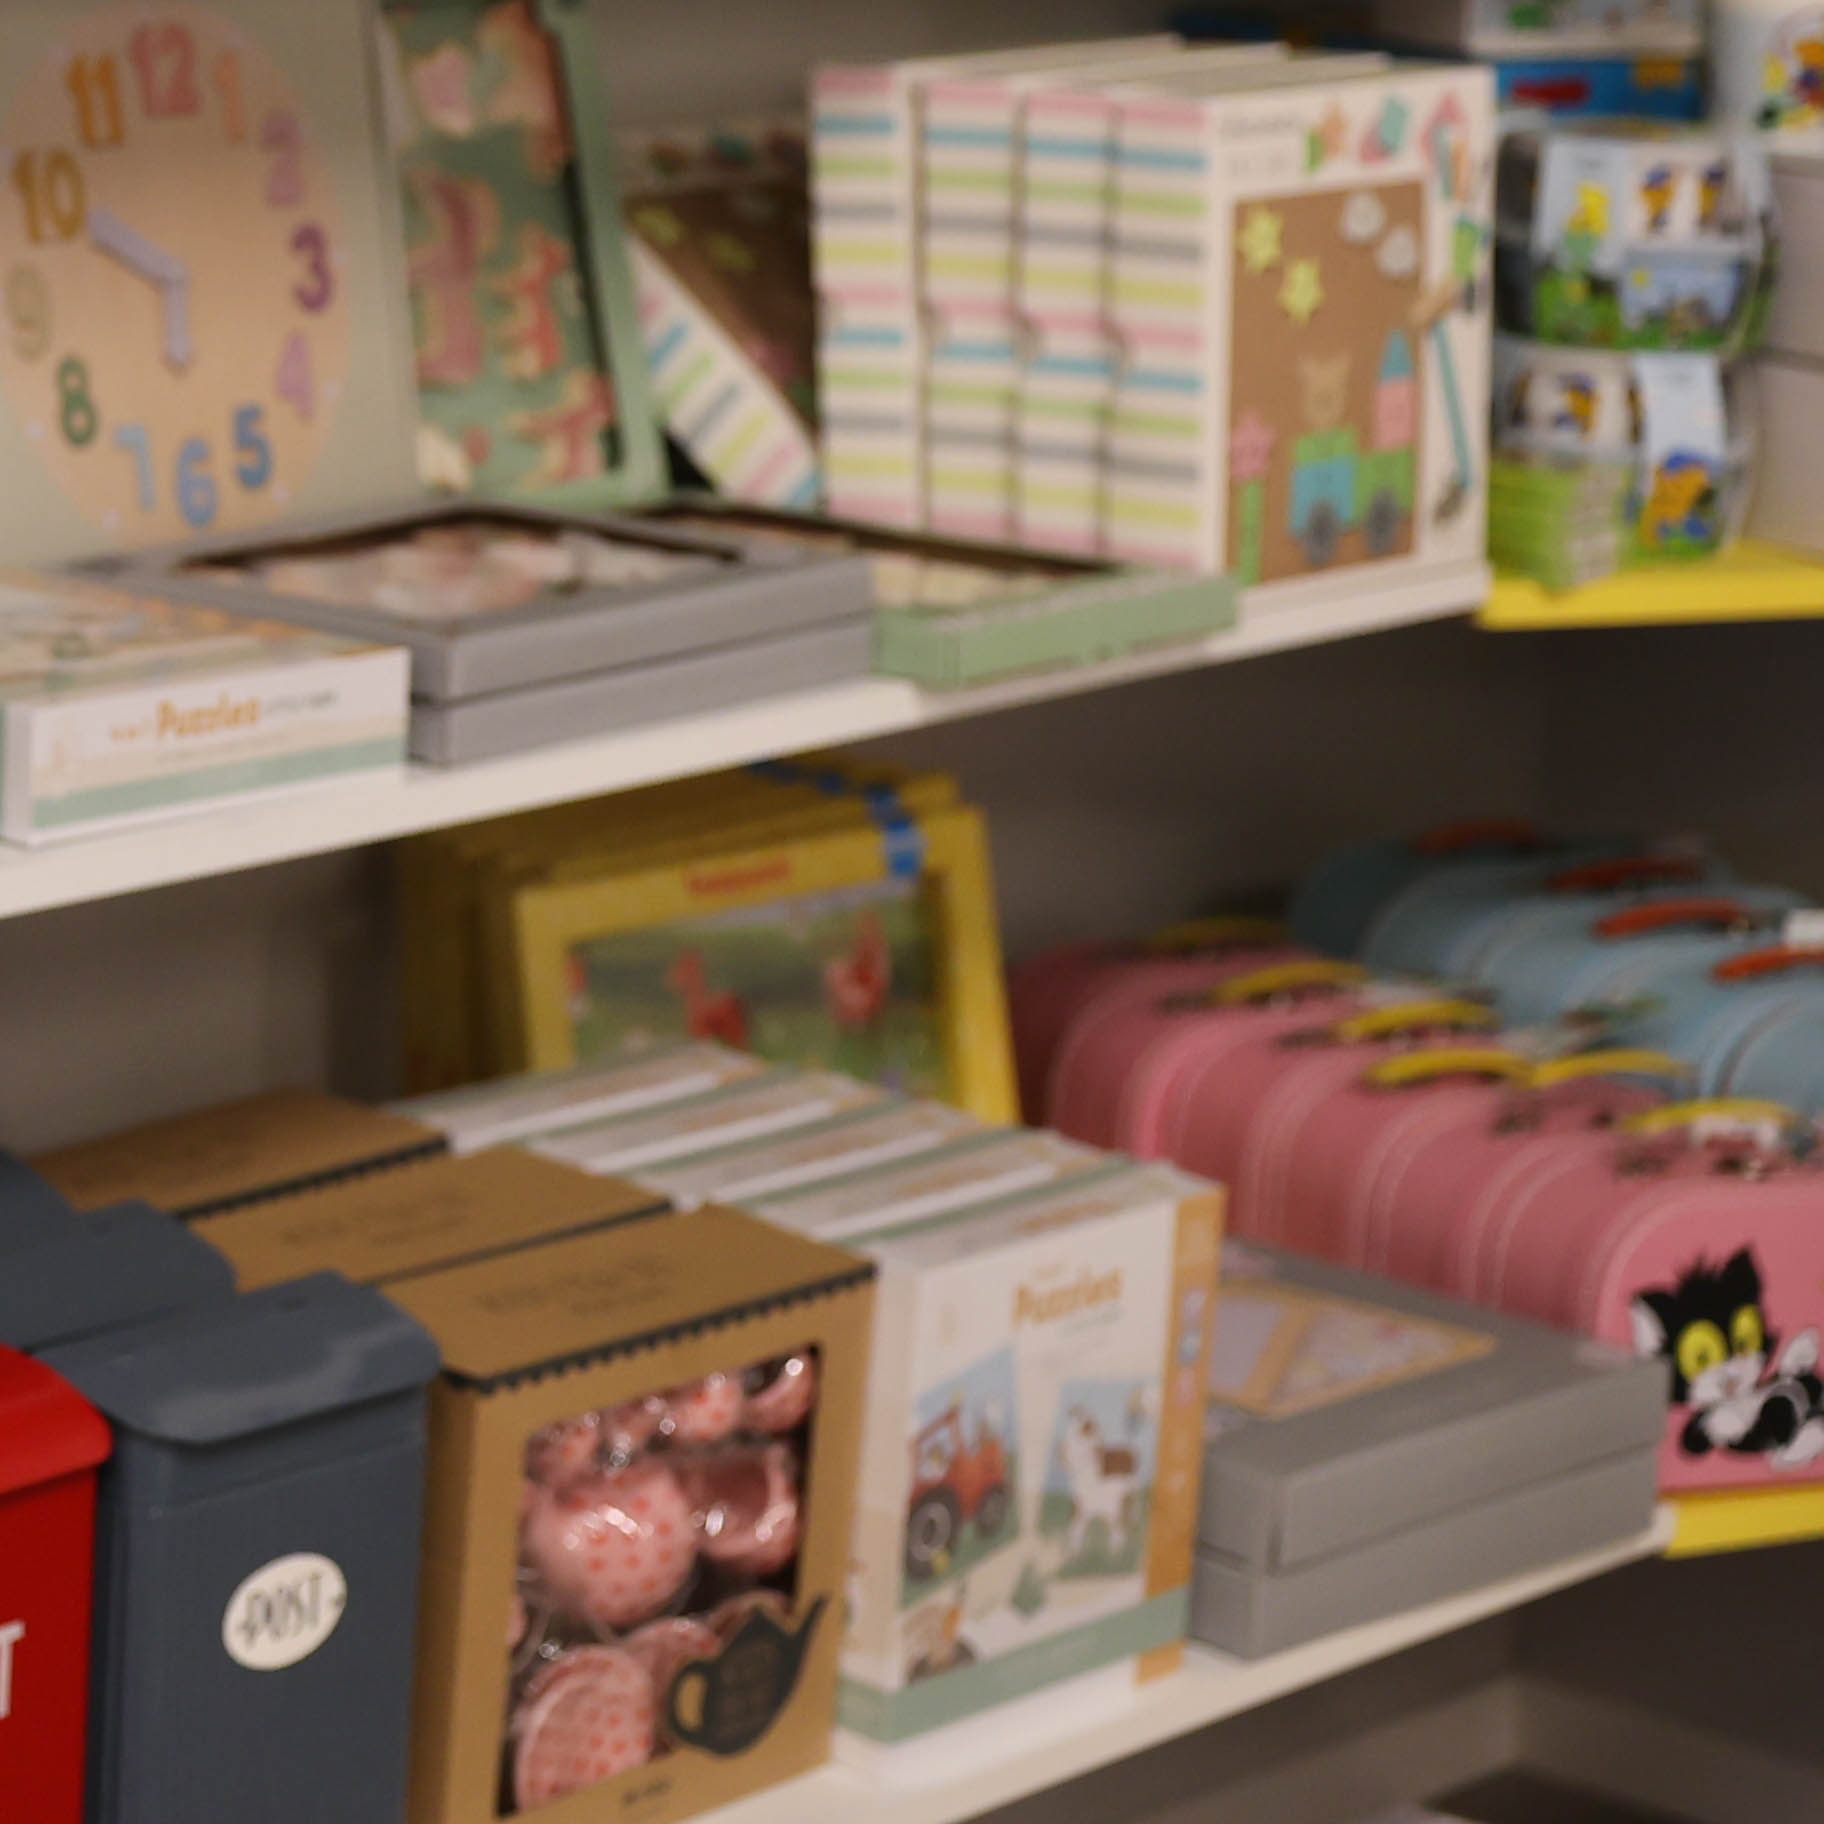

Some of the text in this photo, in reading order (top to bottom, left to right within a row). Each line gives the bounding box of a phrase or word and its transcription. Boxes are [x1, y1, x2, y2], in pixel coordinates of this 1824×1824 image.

[65, 52, 126, 149] 11
[131, 21, 200, 119] 12
[12, 150, 87, 244] 10
[290, 223, 333, 313] 3
[54, 353, 97, 447] 8
[174, 436, 218, 529] 6
[229, 405, 272, 490] 5
